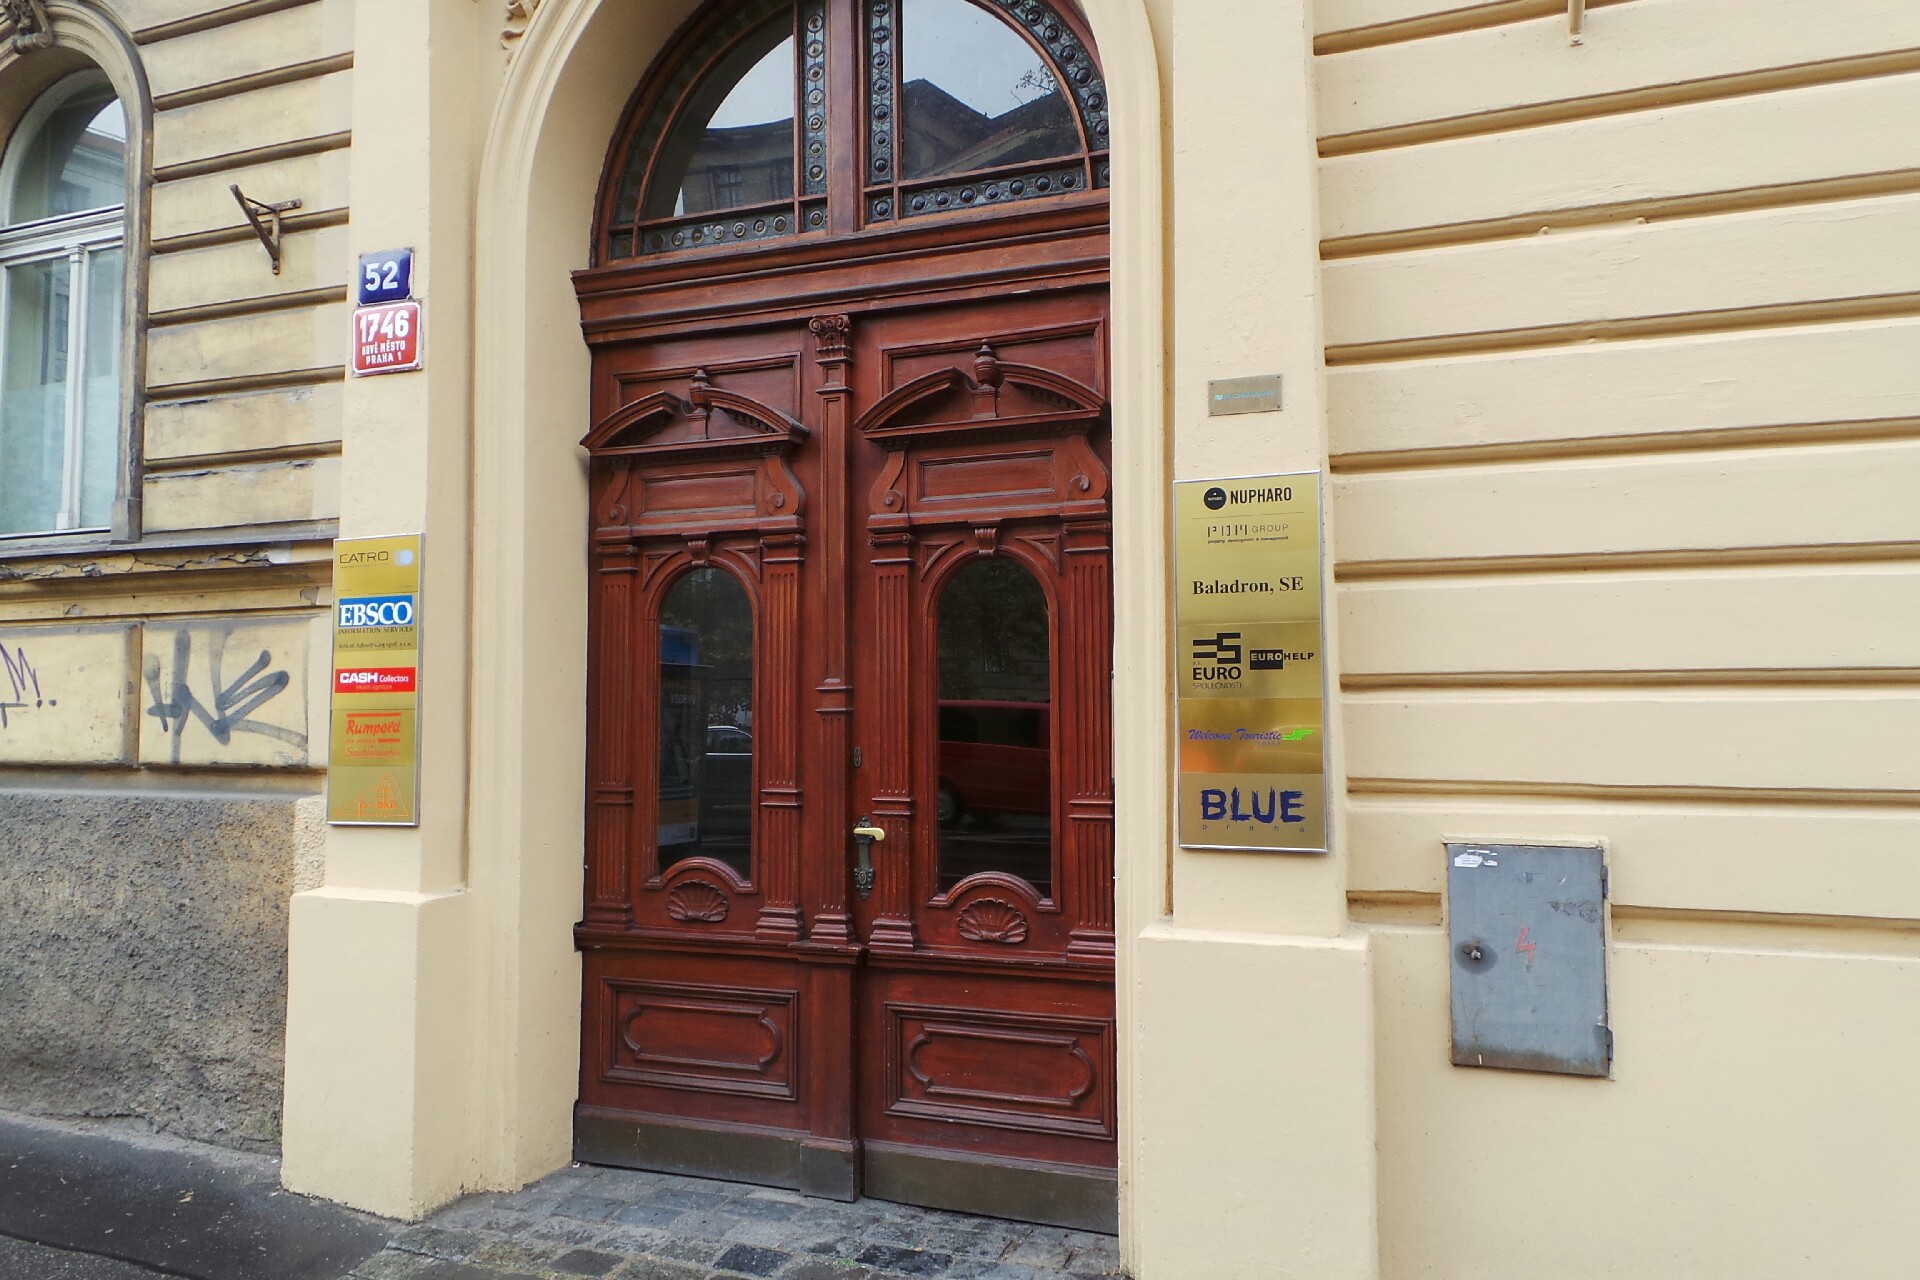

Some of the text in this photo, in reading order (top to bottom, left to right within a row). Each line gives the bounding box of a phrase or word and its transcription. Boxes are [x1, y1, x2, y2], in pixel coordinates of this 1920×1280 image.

[364, 260, 399, 291] 52
[360, 309, 409, 343] 1746
[380, 339, 406, 353] MĚSTO
[365, 351, 402, 366] PRAHA 1
[1230, 487, 1292, 505] NUPHARO
[1251, 523, 1289, 533] GROUP
[339, 550, 389, 564] CATRO
[1192, 576, 1304, 596] Baladron, SE
[340, 601, 413, 626] EBSCO
[338, 625, 413, 635] INFORMATION SERVICES
[340, 672, 409, 684] CASH Collectors
[1192, 666, 1242, 681] EURO
[346, 719, 401, 737] Rumpold
[1188, 728, 1281, 741] Welcome Touristic
[1201, 786, 1305, 824] BLUE
